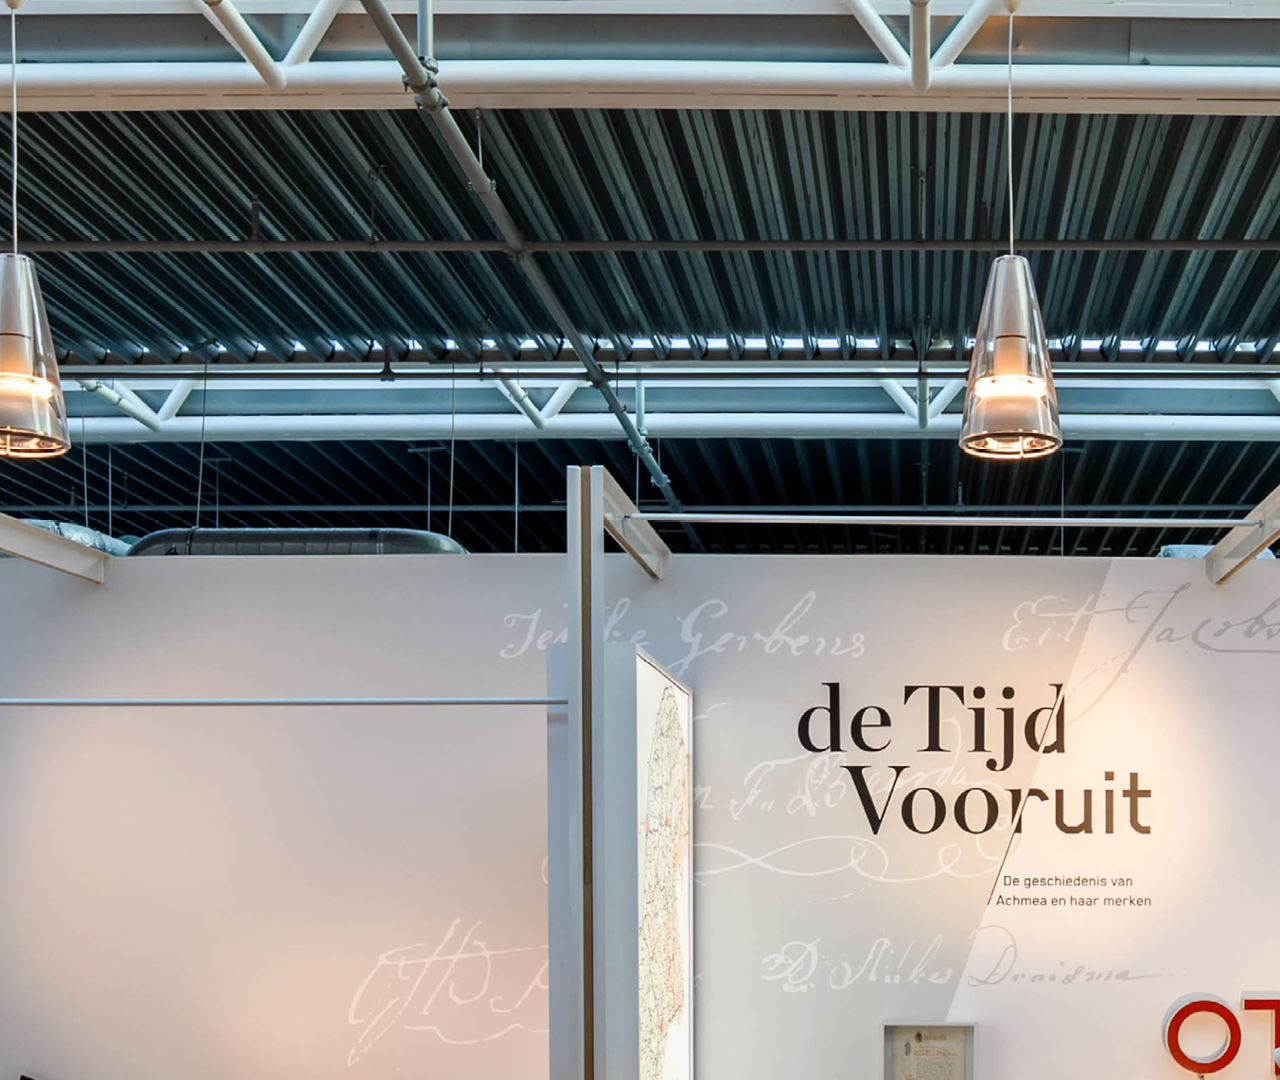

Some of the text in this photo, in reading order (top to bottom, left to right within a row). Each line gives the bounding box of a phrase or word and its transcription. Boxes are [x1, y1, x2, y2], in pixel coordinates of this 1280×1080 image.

[797, 682, 1066, 772] de Tijd
[840, 765, 1152, 836] Vooruit
[996, 895, 1151, 906] Achmea en haar merken
[1004, 875, 1133, 889] De geschiedenis van
